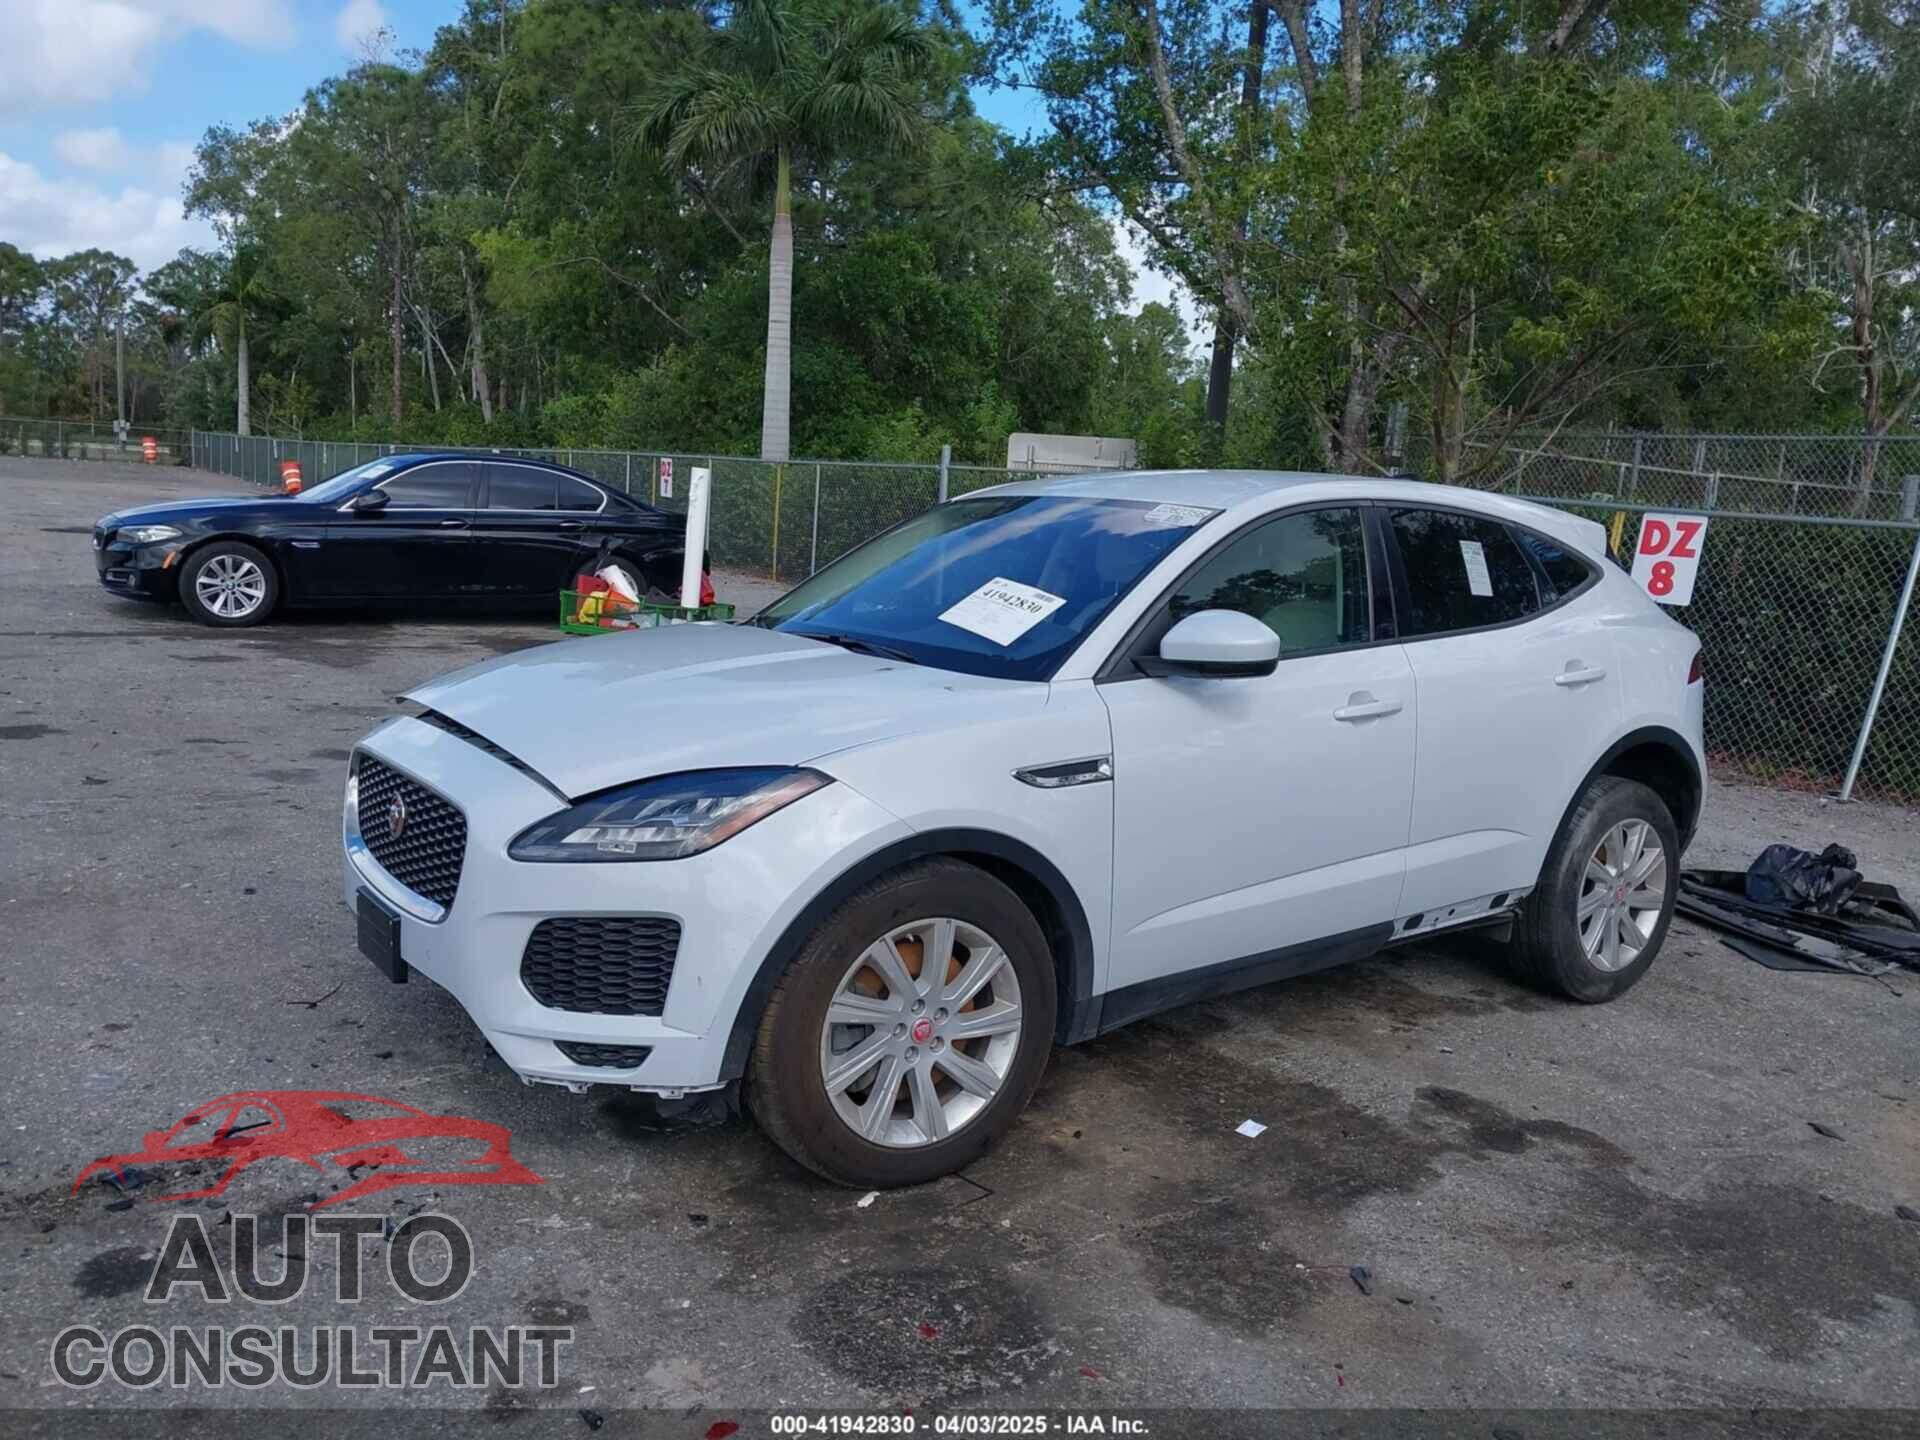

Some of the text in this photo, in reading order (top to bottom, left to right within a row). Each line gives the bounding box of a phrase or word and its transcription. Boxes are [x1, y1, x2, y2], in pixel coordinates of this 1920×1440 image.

[1639, 519, 1703, 558] DZ
[1647, 560, 1676, 597] 8
[982, 588, 1043, 614] 41942830
